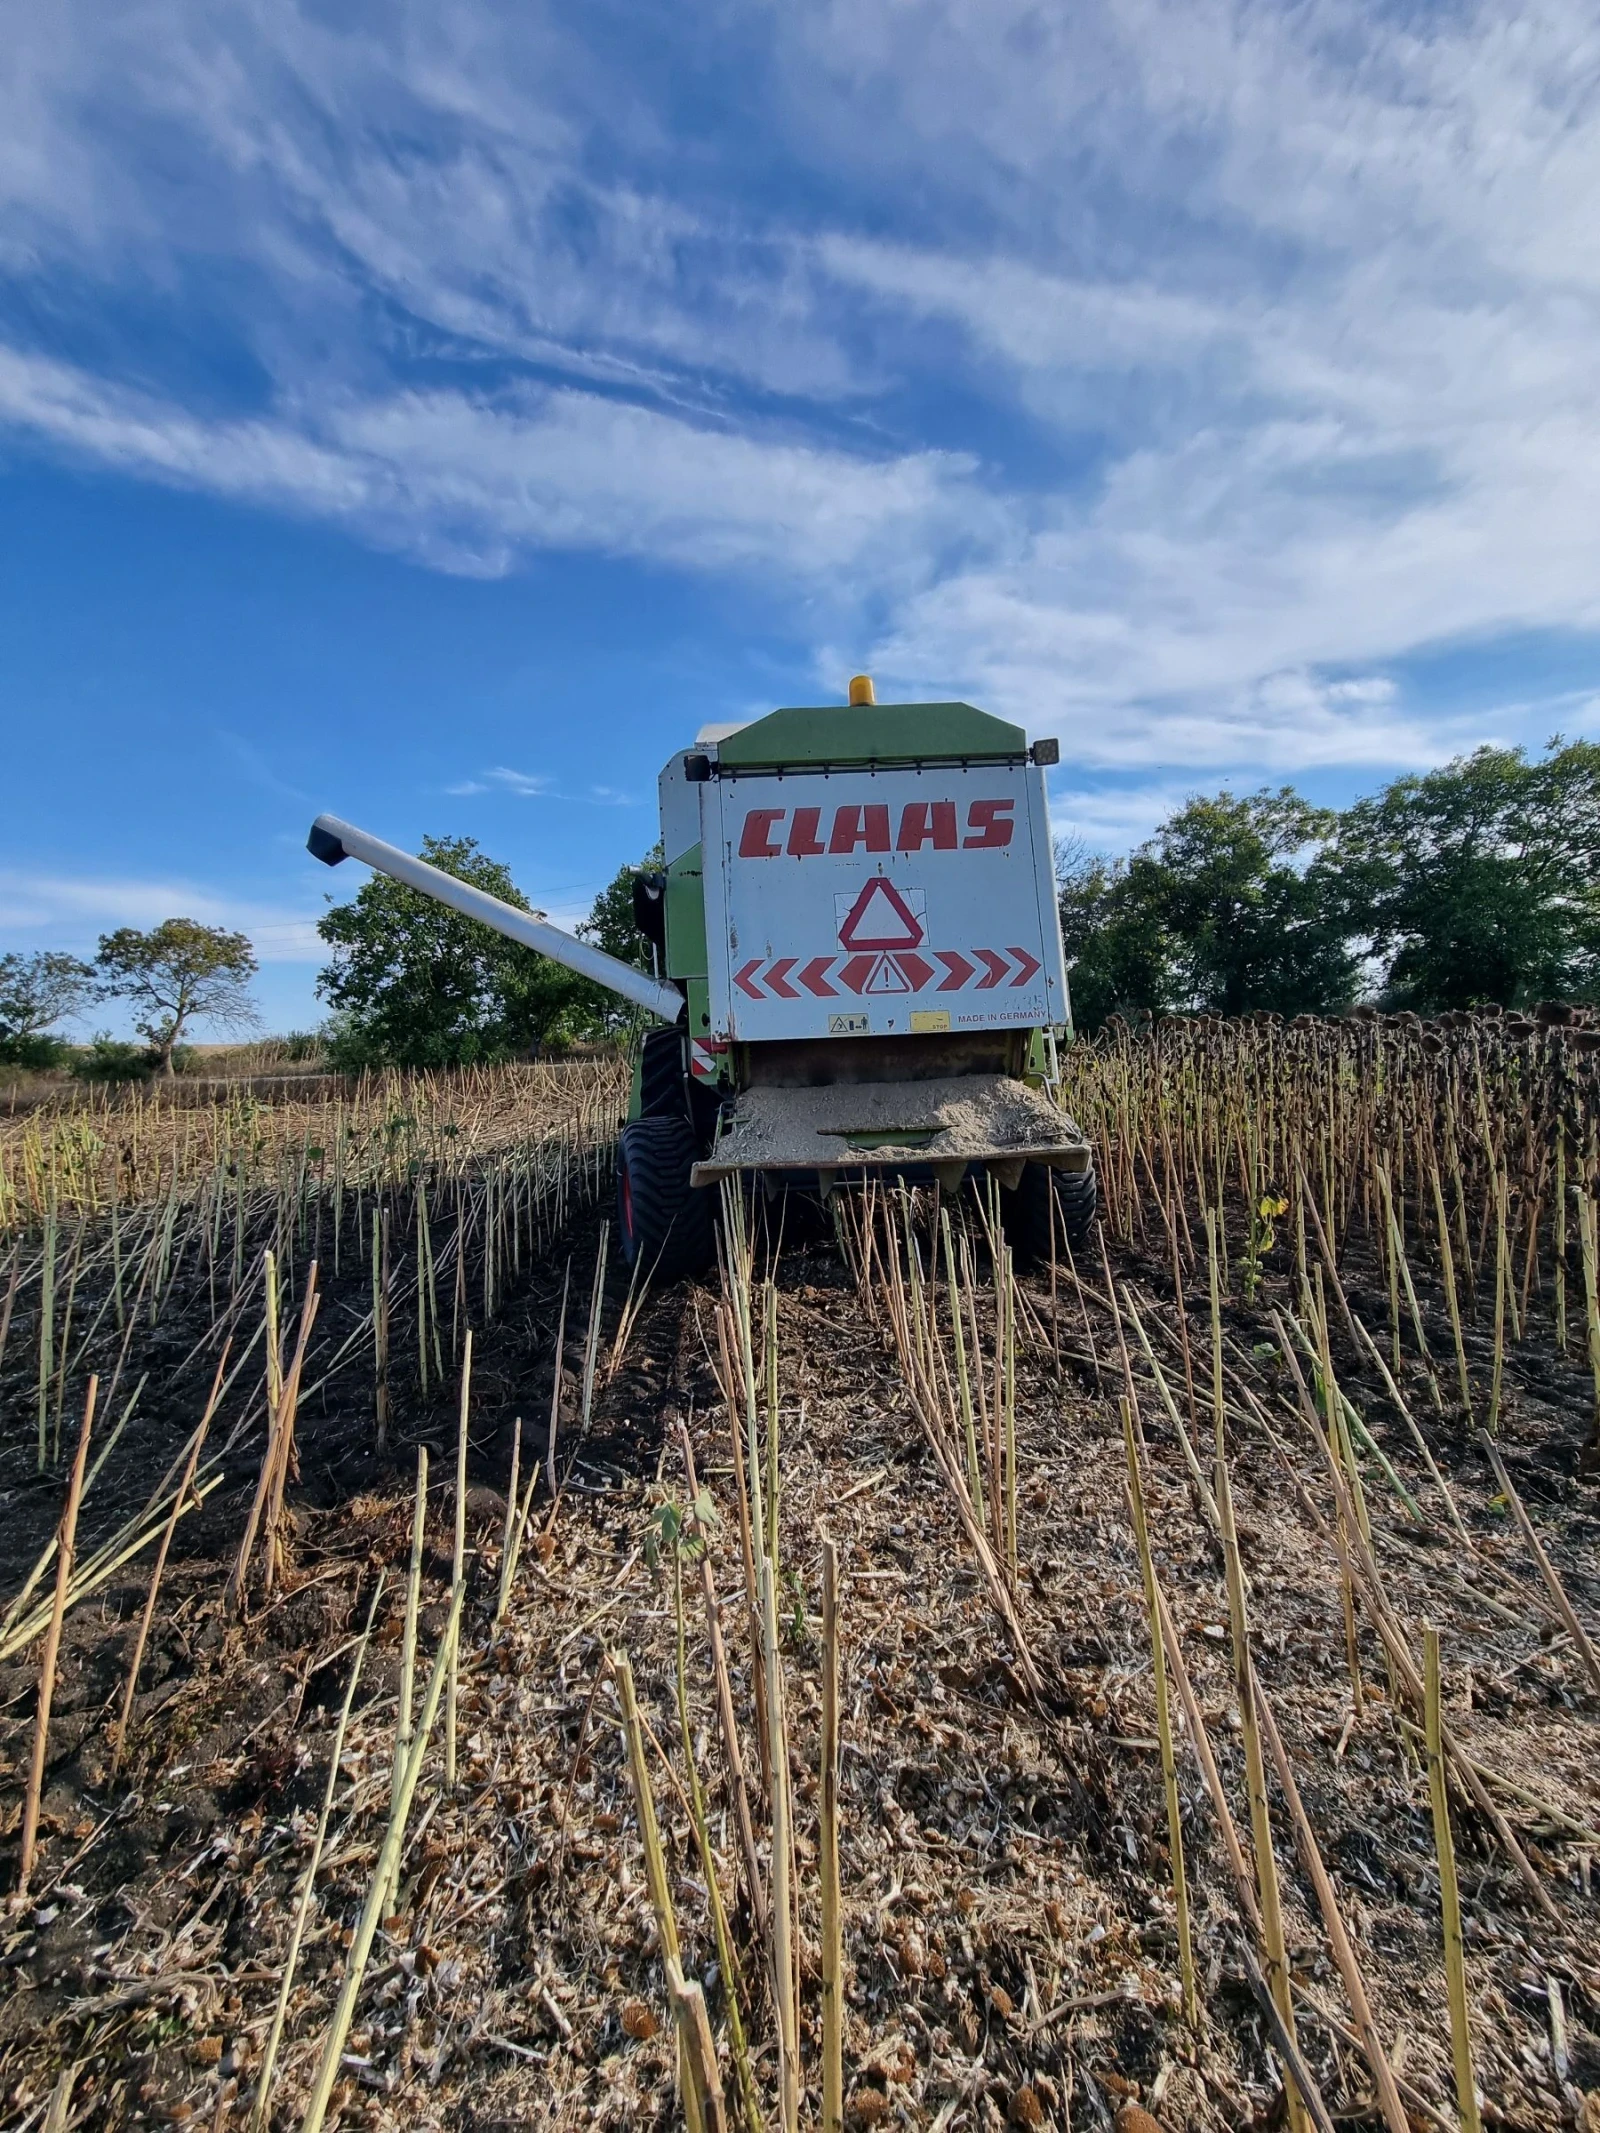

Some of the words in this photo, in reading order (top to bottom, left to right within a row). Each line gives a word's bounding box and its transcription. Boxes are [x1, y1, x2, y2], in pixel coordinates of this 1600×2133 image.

[739, 799, 1015, 857] CLAAS
[958, 1014, 986, 1023] MADE
[987, 1013, 997, 1021] IN
[999, 1010, 1046, 1021] GERMANY
